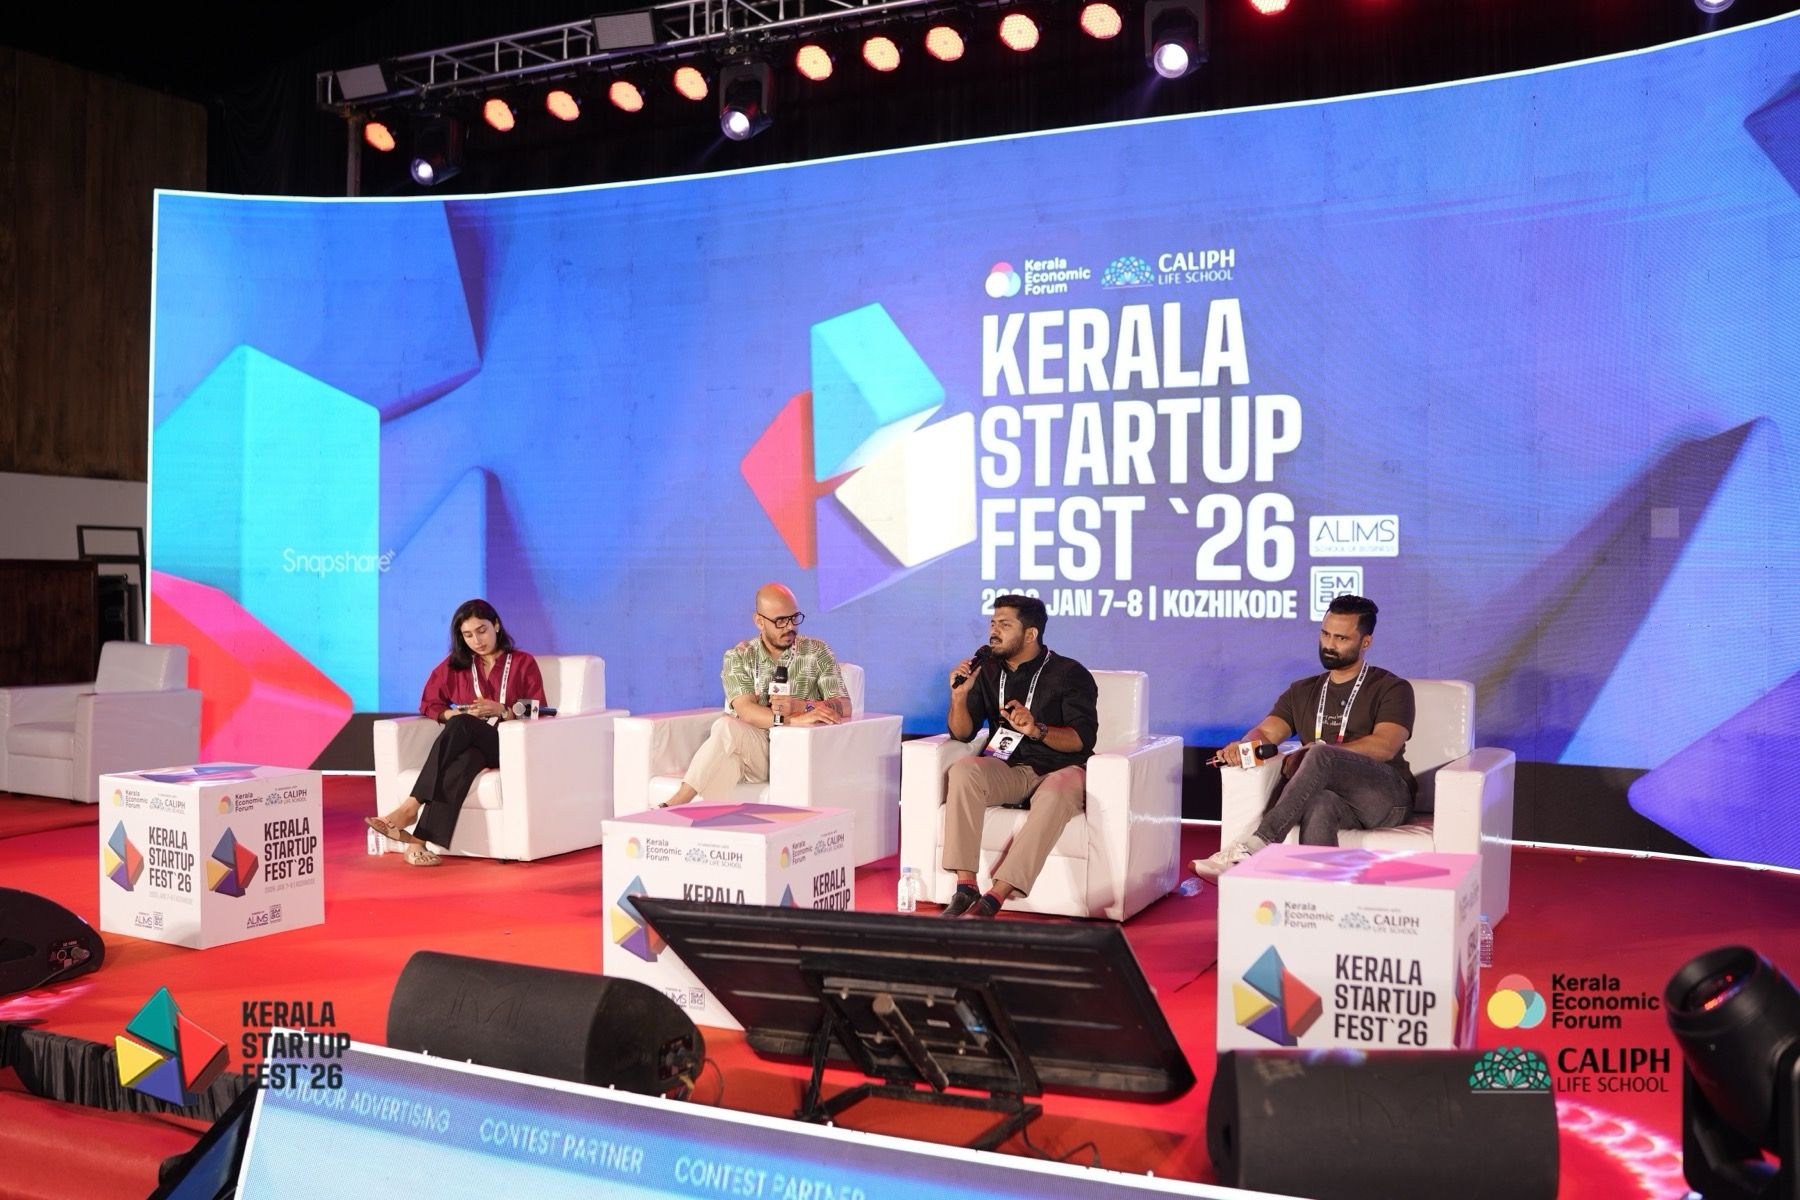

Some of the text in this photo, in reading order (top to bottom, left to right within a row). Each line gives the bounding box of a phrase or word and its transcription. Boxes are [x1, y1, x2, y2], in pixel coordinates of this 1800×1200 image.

[1025, 257, 1067, 271] Kerala
[1158, 249, 1235, 272] CALIPH
[1025, 267, 1091, 284] Economic
[1158, 269, 1233, 285] LIFE SCHOOL
[1025, 282, 1067, 295] Forum
[982, 298, 1250, 397] KERALA
[980, 395, 1302, 489] STARTUP
[981, 495, 1146, 582] FEST
[1316, 519, 1395, 542] ALIMS
[1046, 588, 1092, 617] JAN
[1163, 588, 1297, 619] KOZHIKODE
[235, 792, 253, 800] Kerala
[235, 797, 264, 806] Economic
[284, 789, 307, 799] CALIPH
[149, 826, 188, 850] KERALA
[265, 817, 310, 841] KERALA
[265, 836, 317, 861] STARTUP
[646, 838, 668, 846] Kerala
[646, 846, 682, 856] Economic
[149, 847, 194, 872] STARTUP
[646, 854, 670, 862] Forum
[710, 850, 742, 862] CALIPH
[814, 866, 846, 898] KERALA
[1284, 901, 1316, 911] Kerala
[1284, 910, 1334, 921] Economic
[1284, 919, 1316, 928] Forum
[1374, 914, 1420, 928] CALIPH
[1336, 954, 1422, 986] KERALA
[1334, 984, 1436, 1017] STARTUP
[351, 1090, 450, 1134] ADVERTISING
[479, 1117, 644, 1175] CONTEST PARTNER
[674, 1156, 767, 1199] CONTEST
